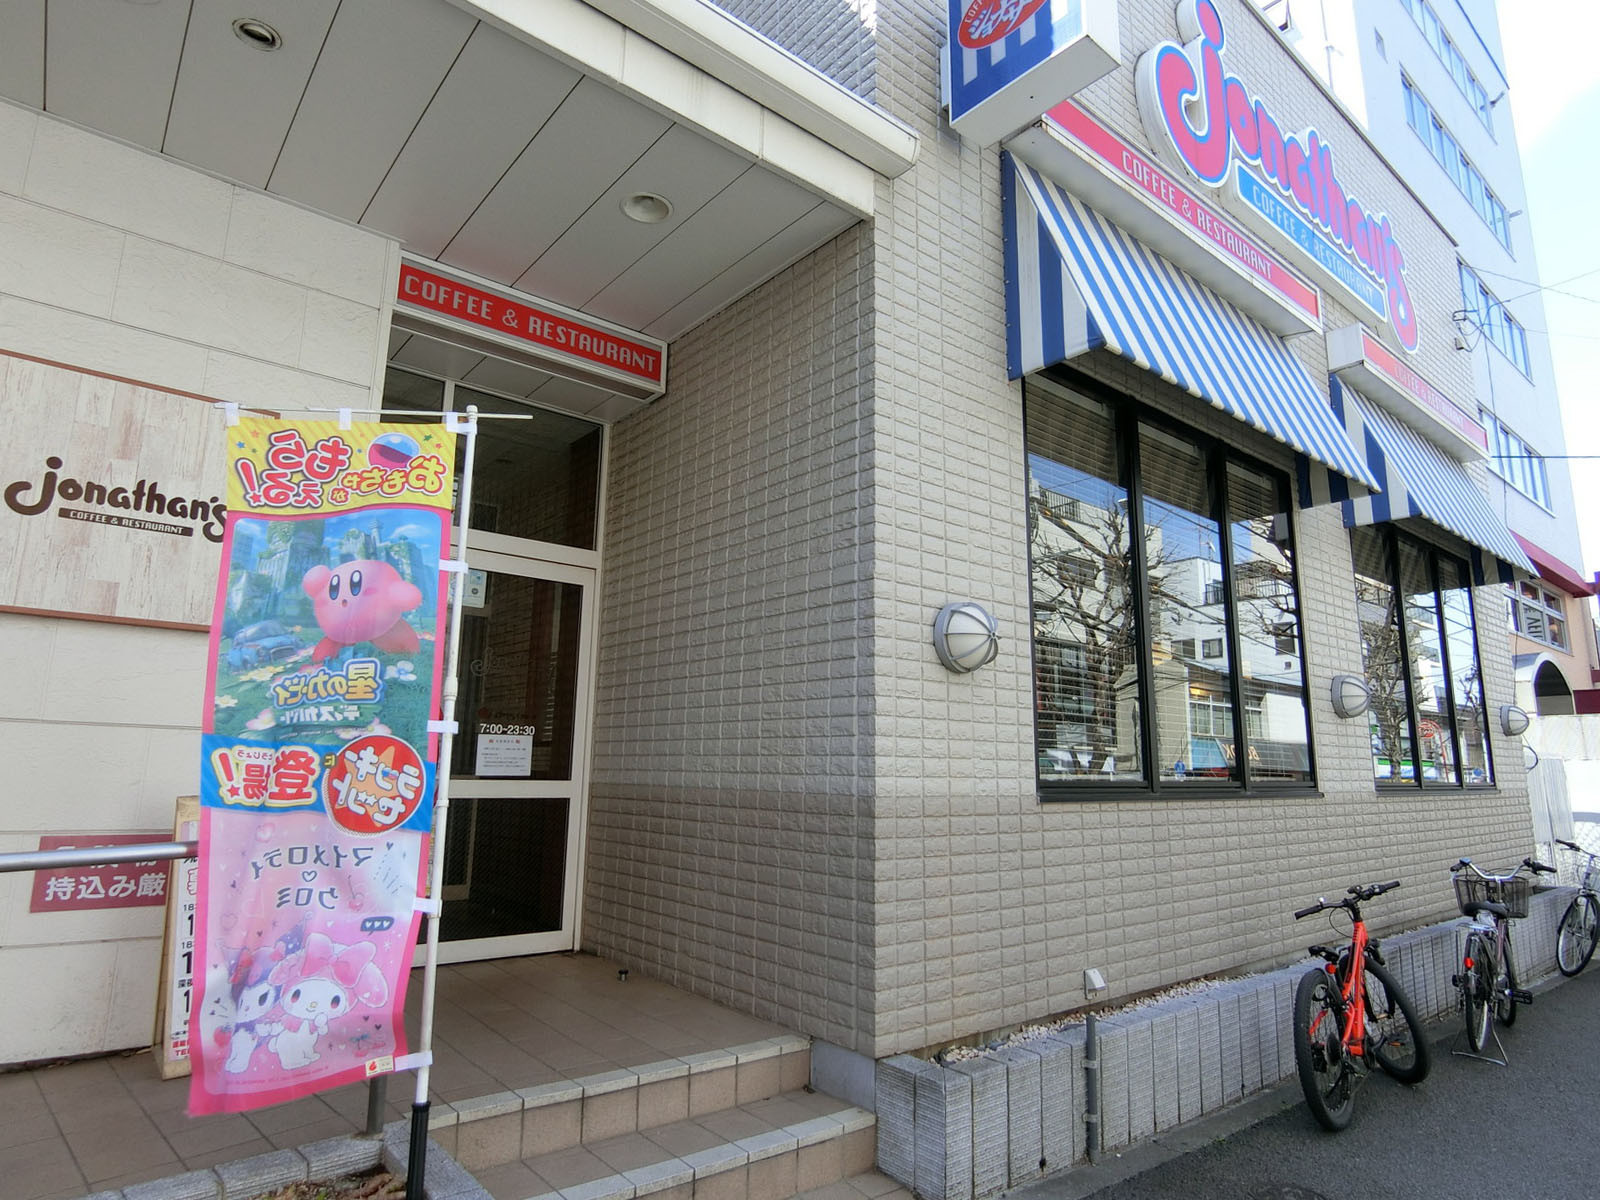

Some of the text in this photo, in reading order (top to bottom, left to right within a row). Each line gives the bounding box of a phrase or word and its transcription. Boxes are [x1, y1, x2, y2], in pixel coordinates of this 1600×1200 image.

[1121, 150, 1274, 280] COFFEE & RESTAURANT
[1252, 185, 1374, 301] COFFEE & RESTAURANT
[404, 273, 657, 373] COFFEE & RESTAURANT
[68, 509, 184, 535] COFFEE & RESTAURANT
[45, 872, 167, 902] 持込み厳
